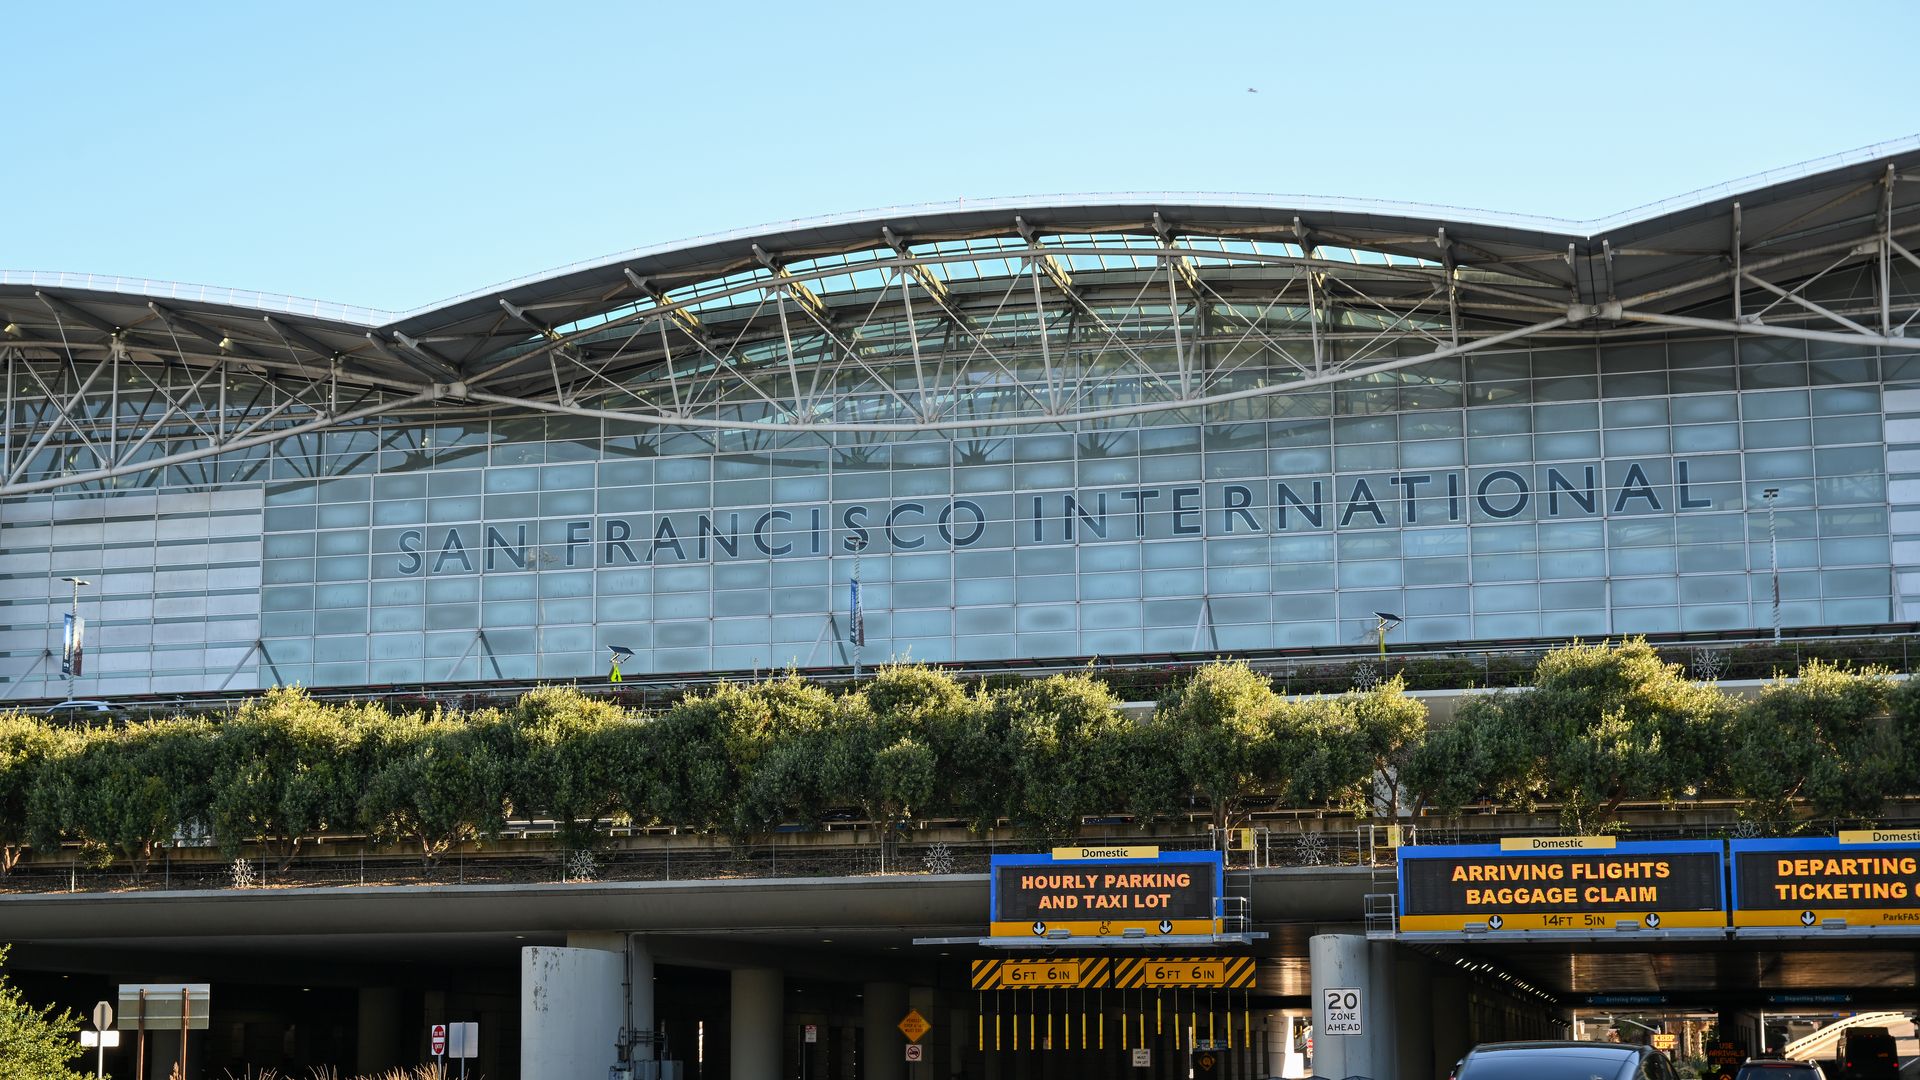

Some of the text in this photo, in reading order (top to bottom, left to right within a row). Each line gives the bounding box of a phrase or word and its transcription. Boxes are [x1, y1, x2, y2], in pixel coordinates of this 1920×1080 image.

[397, 460, 1713, 575] SAN FRANCISCO INTERNATIONAL
[1533, 839, 1584, 849] Domestic
[1081, 848, 1129, 858] Domestic
[1452, 862, 1670, 882] ARRIVING FLIGHTS
[1778, 857, 1917, 876] DEPARTING
[1021, 873, 1191, 890] HOURLY PARKING
[1466, 886, 1657, 905] BAGGAGE CLAIM
[1775, 882, 1908, 900] TICKETING
[1038, 893, 1171, 910] AND TAXI LOT
[1543, 914, 1605, 926] 14FT 5IN
[1011, 966, 1070, 981] 6FT 6IN
[1155, 965, 1215, 980] 6FT 6IN
[1328, 993, 1358, 1010] 20
[1653, 1034, 1675, 1042] KEEP
[1654, 1041, 1674, 1050] LEFT
